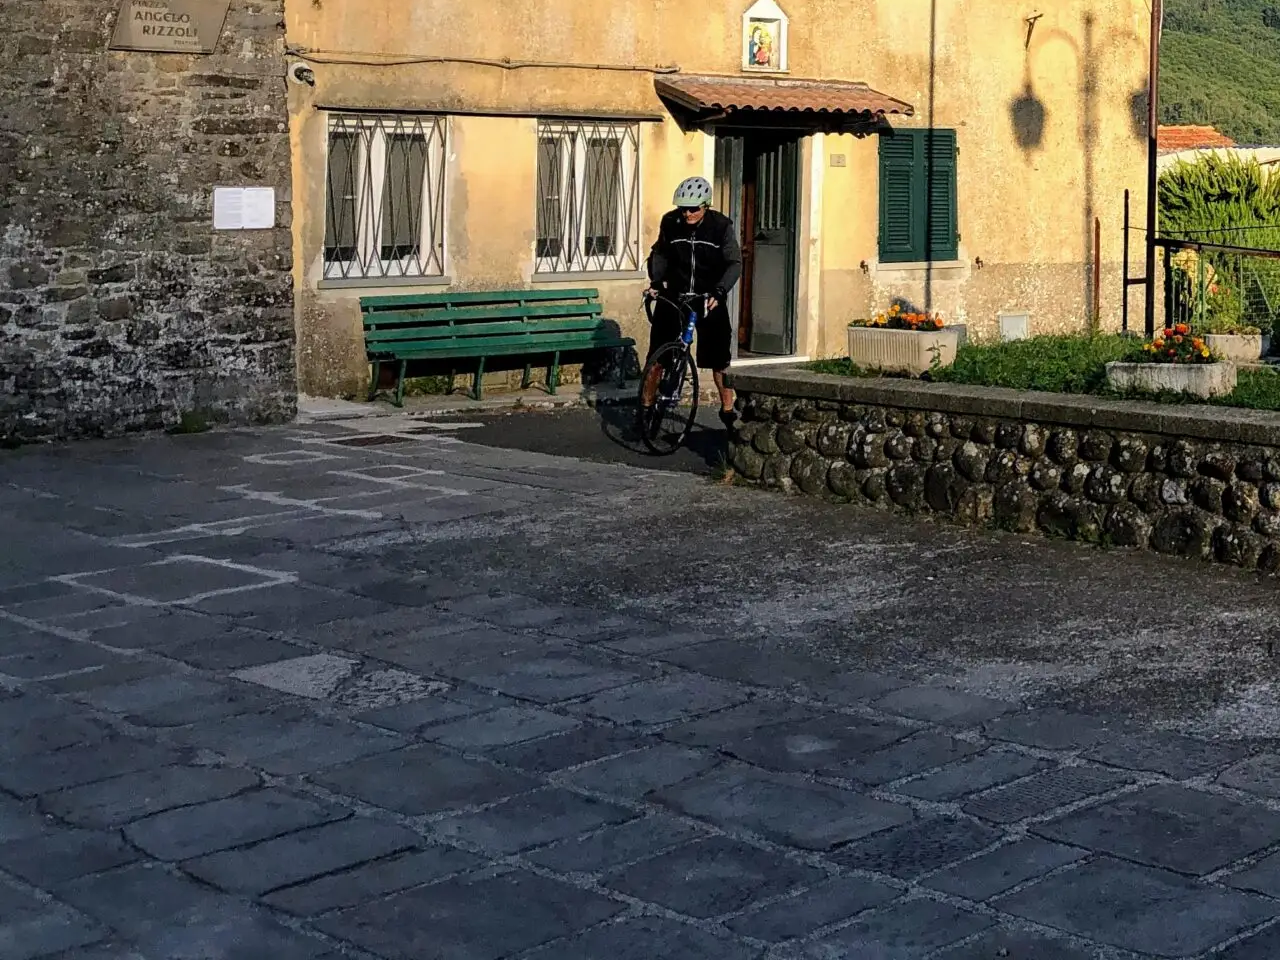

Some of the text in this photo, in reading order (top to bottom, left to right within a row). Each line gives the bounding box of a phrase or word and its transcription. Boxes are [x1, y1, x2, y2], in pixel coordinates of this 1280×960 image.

[132, 0, 168, 8] PIAZZA
[135, 11, 190, 23] ANGELO
[142, 25, 198, 37] RIZZOLI
